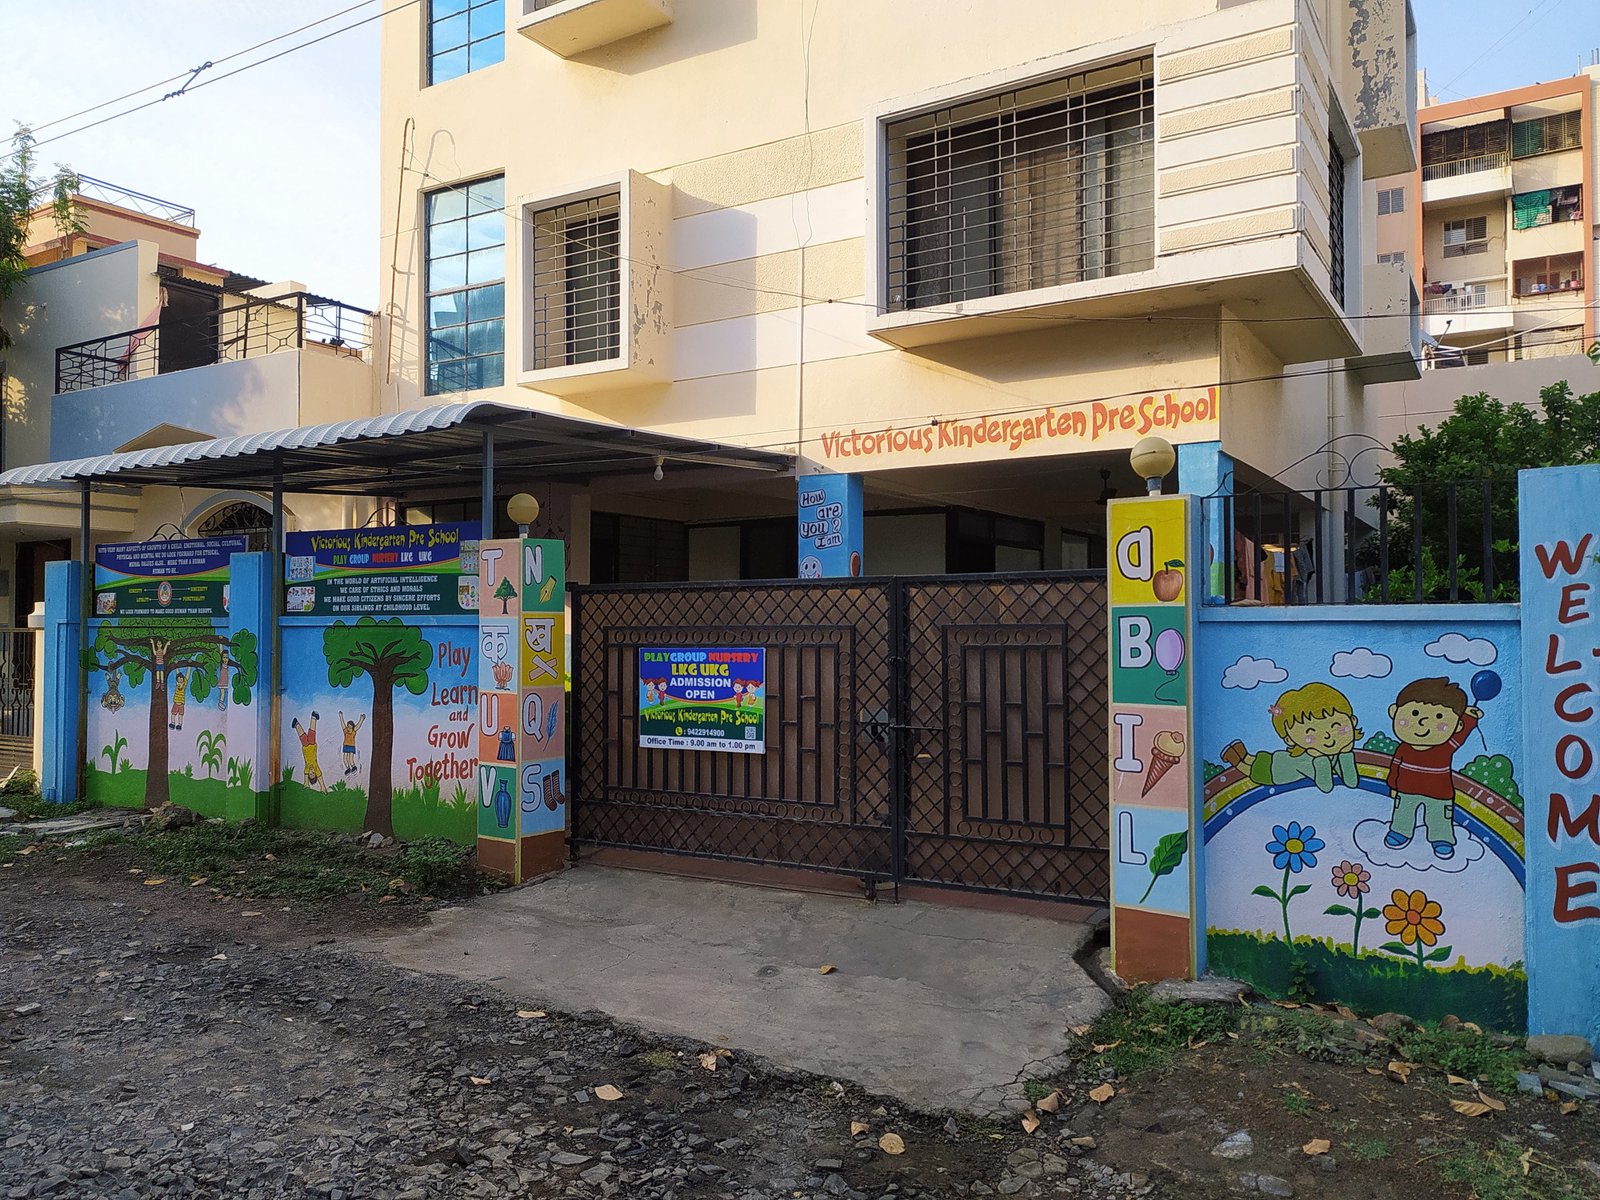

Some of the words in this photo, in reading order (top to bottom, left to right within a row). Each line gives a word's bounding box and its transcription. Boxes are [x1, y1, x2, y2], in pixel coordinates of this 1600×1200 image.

[821, 427, 932, 458] Victorious
[937, 407, 1085, 451] Kindergarten
[802, 491, 823, 504] How
[818, 505, 840, 518] are
[311, 534, 351, 552] Victorious
[353, 532, 406, 550] Kindergarten
[408, 530, 425, 548] Pre
[427, 528, 459, 547] School
[333, 554, 347, 565] PLAY
[349, 553, 370, 564] GROUP
[372, 552, 398, 563] NURSERY
[401, 552, 413, 562] LKG
[418, 551, 432, 562] UKG
[481, 548, 503, 586] T
[524, 545, 543, 586] N
[370, 576, 399, 584] ARTIFICIAL
[351, 604, 374, 612] SIBLINGS
[392, 594, 416, 602] SINCERE
[481, 625, 510, 665] क
[524, 618, 555, 655] ख
[1118, 615, 1153, 669] B
[437, 640, 471, 678] Play
[671, 664, 698, 676] LKG
[699, 664, 730, 676] UKG
[708, 652, 758, 663] NURSERY
[431, 682, 479, 706] Learn
[670, 678, 731, 688] ADMISSION
[685, 690, 715, 699] OPEN
[449, 705, 469, 722] and
[480, 693, 499, 736] U
[522, 693, 544, 743] Q
[645, 710, 676, 724] Victorious
[677, 710, 718, 724] Kindergarten
[720, 710, 734, 724] Pre
[735, 710, 760, 726] School
[1113, 713, 1143, 773] I
[1535, 533, 1600, 925] WELCOME
[668, 738, 685, 746] Time
[690, 739, 705, 747] 9.00
[719, 740, 726, 748] to
[728, 740, 743, 749] 1.00
[744, 742, 756, 751] pm
[406, 752, 479, 789] Together
[480, 765, 497, 808] V
[520, 763, 542, 813] S
[1118, 811, 1147, 866] L
